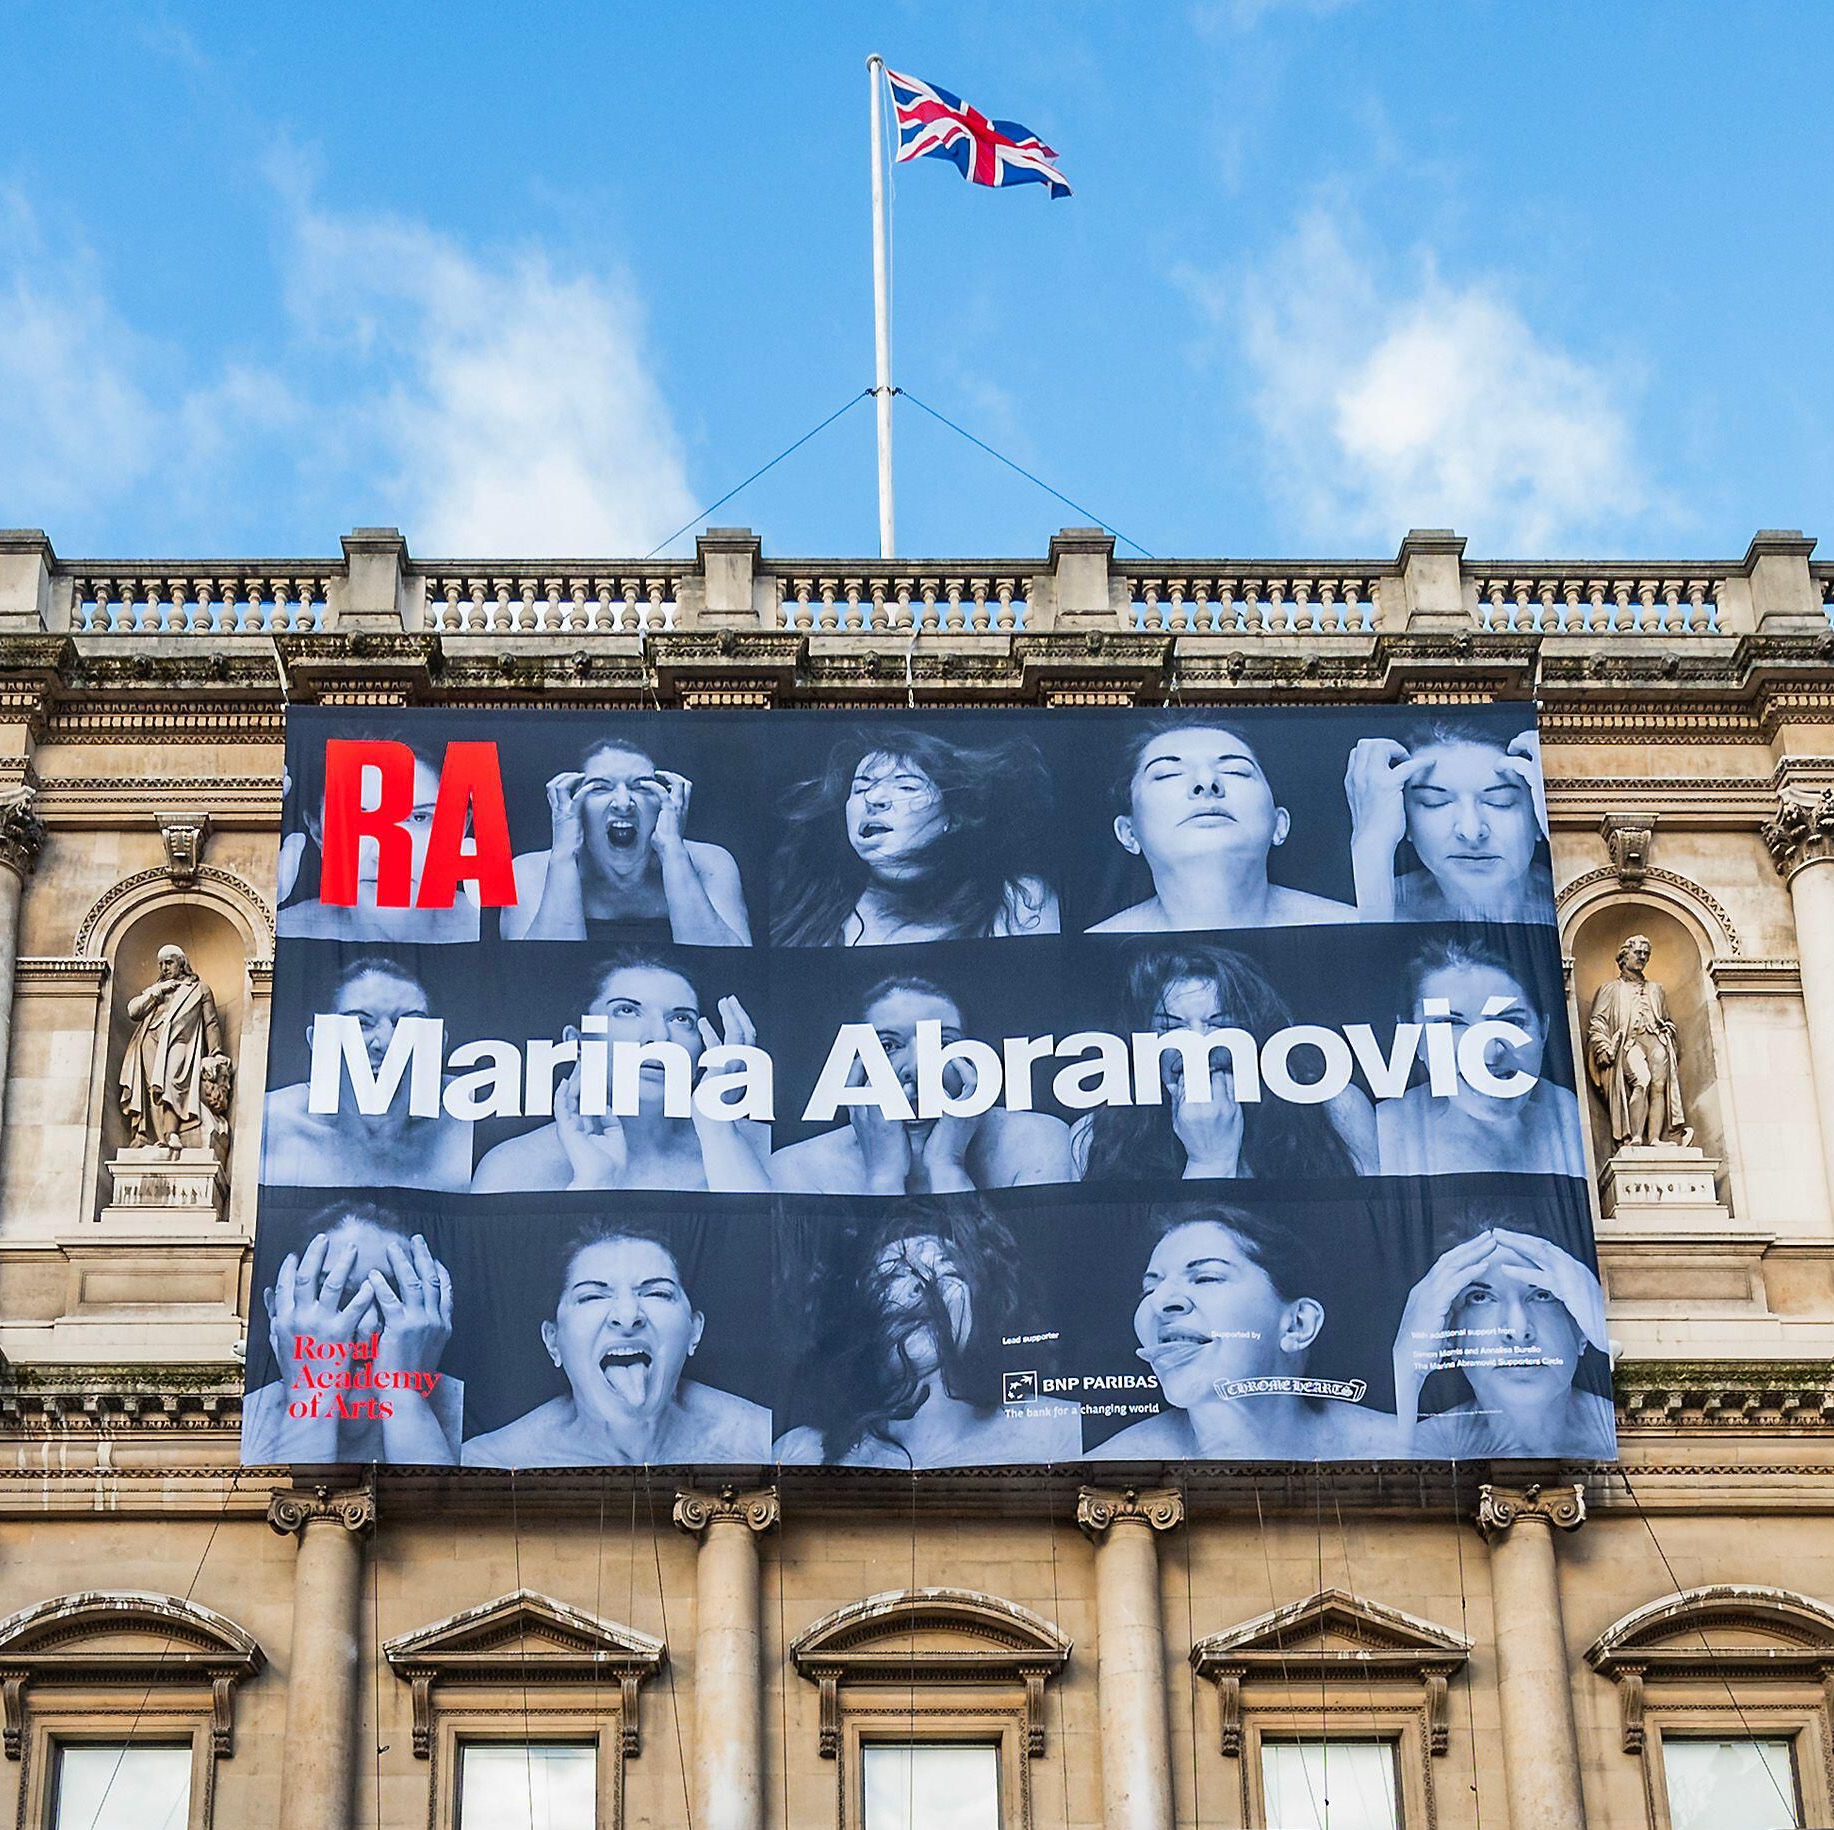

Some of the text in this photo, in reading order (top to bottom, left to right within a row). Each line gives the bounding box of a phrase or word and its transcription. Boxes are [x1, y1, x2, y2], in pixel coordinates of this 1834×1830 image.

[321, 740, 518, 909] RA
[310, 997, 1538, 1121] Marina Abramović
[292, 1332, 379, 1366] Royal
[1002, 1332, 1059, 1345] Lead supporter
[291, 1362, 441, 1398] Academy
[1042, 1375, 1158, 1392] BNP PARIBAS
[288, 1391, 394, 1420] of Arts
[1005, 1402, 1159, 1419] The bank for a changing world
